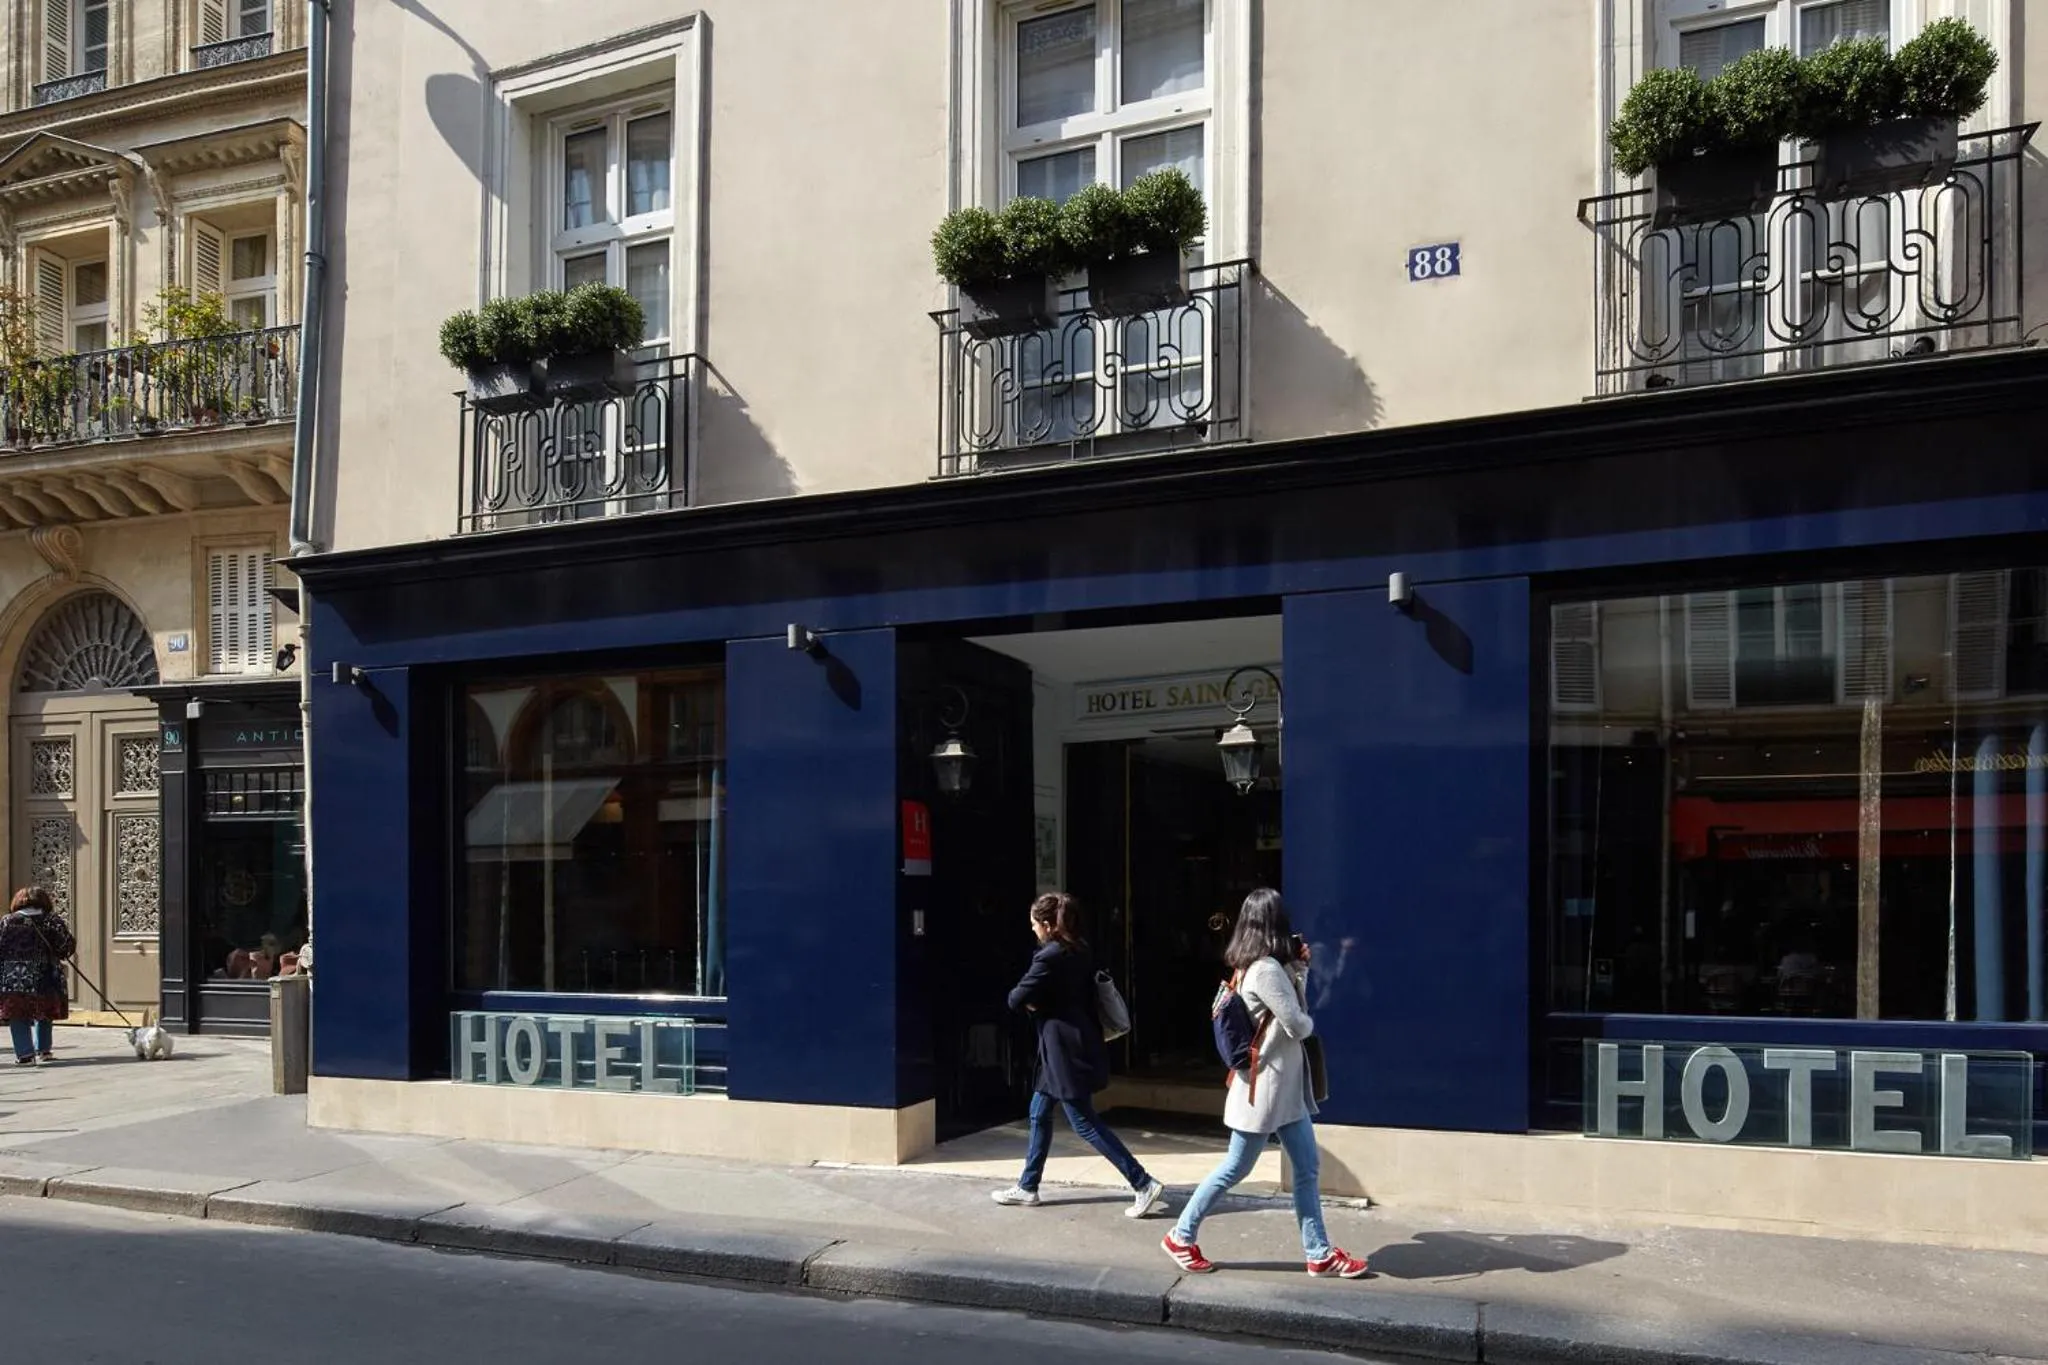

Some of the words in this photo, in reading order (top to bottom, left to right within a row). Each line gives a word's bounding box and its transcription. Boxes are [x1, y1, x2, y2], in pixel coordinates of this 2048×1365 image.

[1414, 247, 1452, 278] 88
[170, 635, 185, 649] 90
[1087, 689, 1157, 713] HOTEL
[1167, 681, 1237, 706] SAINT
[165, 731, 180, 745] 90
[914, 810, 927, 834] H
[460, 1015, 682, 1093] HOTEL
[1598, 1043, 2013, 1157] HOTEL
